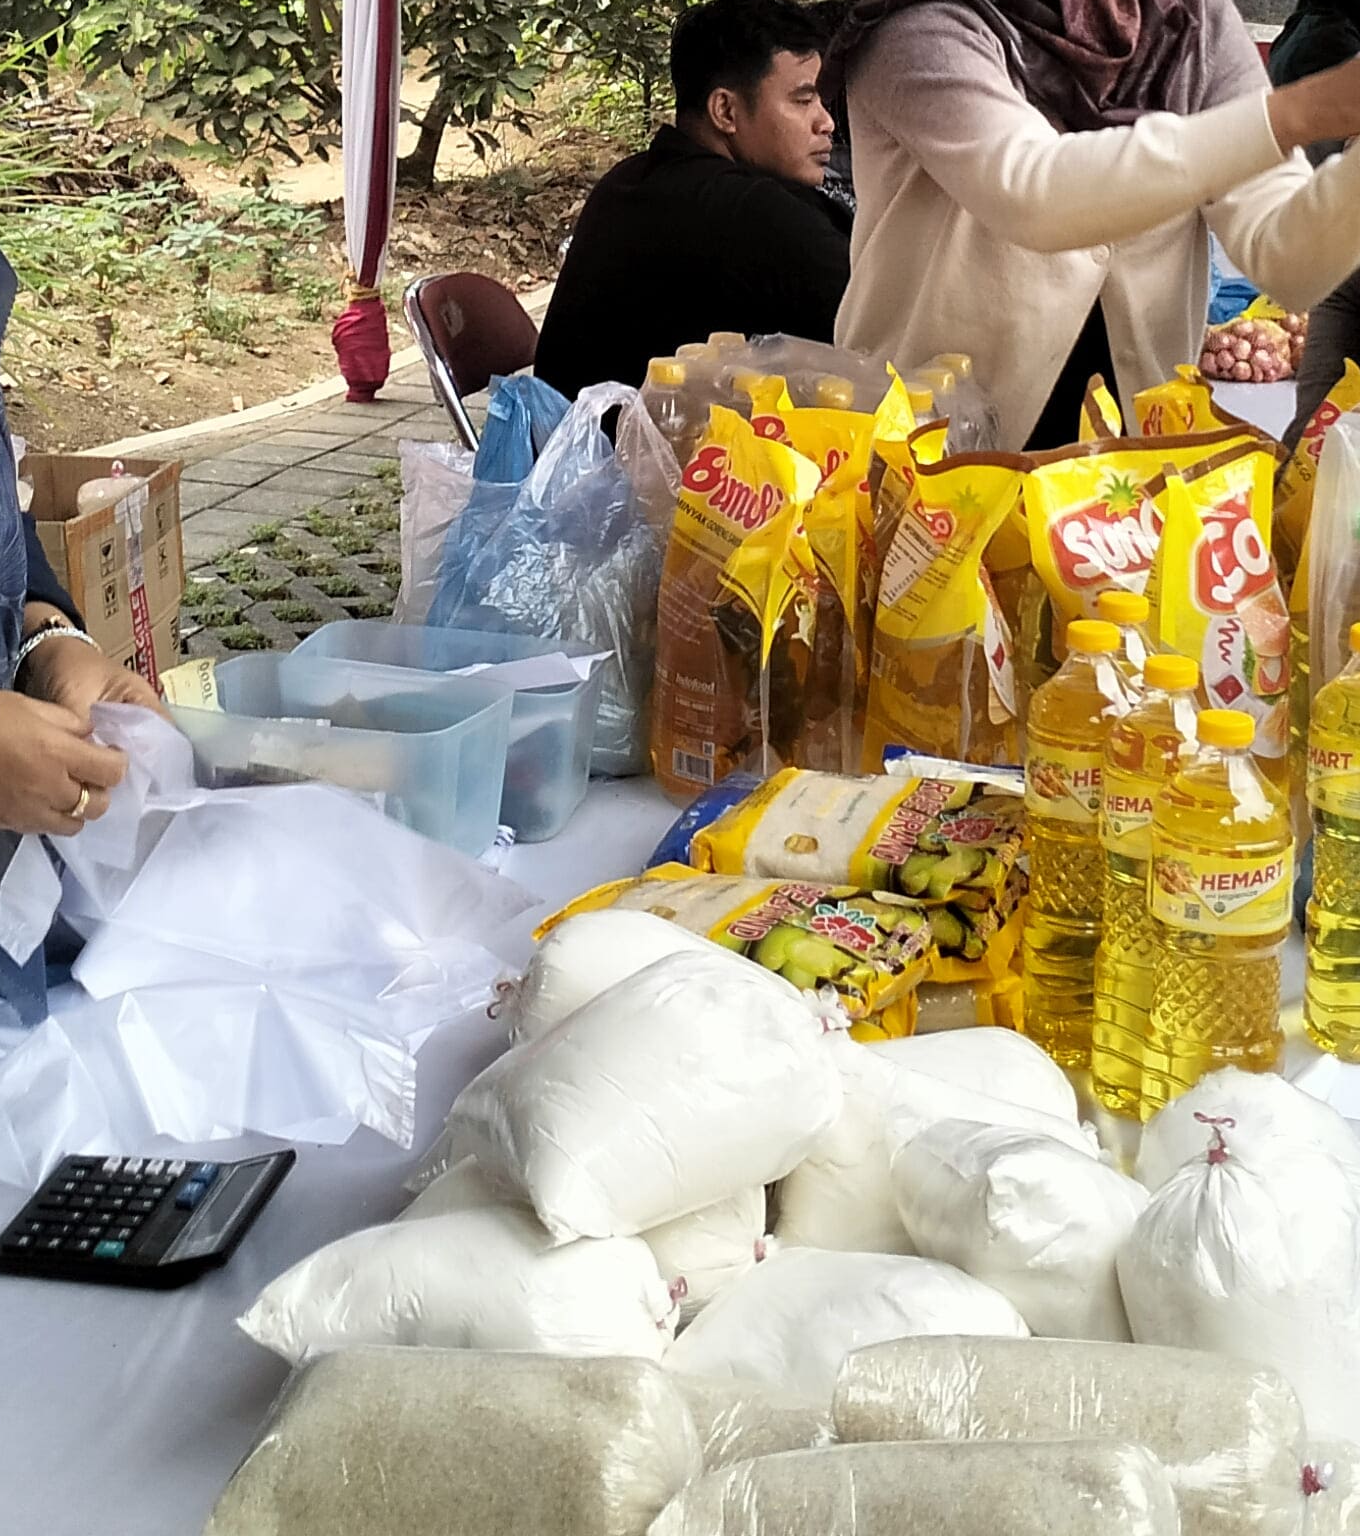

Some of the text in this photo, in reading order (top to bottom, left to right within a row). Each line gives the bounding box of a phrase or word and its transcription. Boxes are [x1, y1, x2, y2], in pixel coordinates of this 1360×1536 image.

[901, 779, 957, 817] ROSE
[1107, 795, 1153, 813] HEMA
[869, 809, 932, 865] BRAND
[1200, 858, 1284, 892] HEMART
